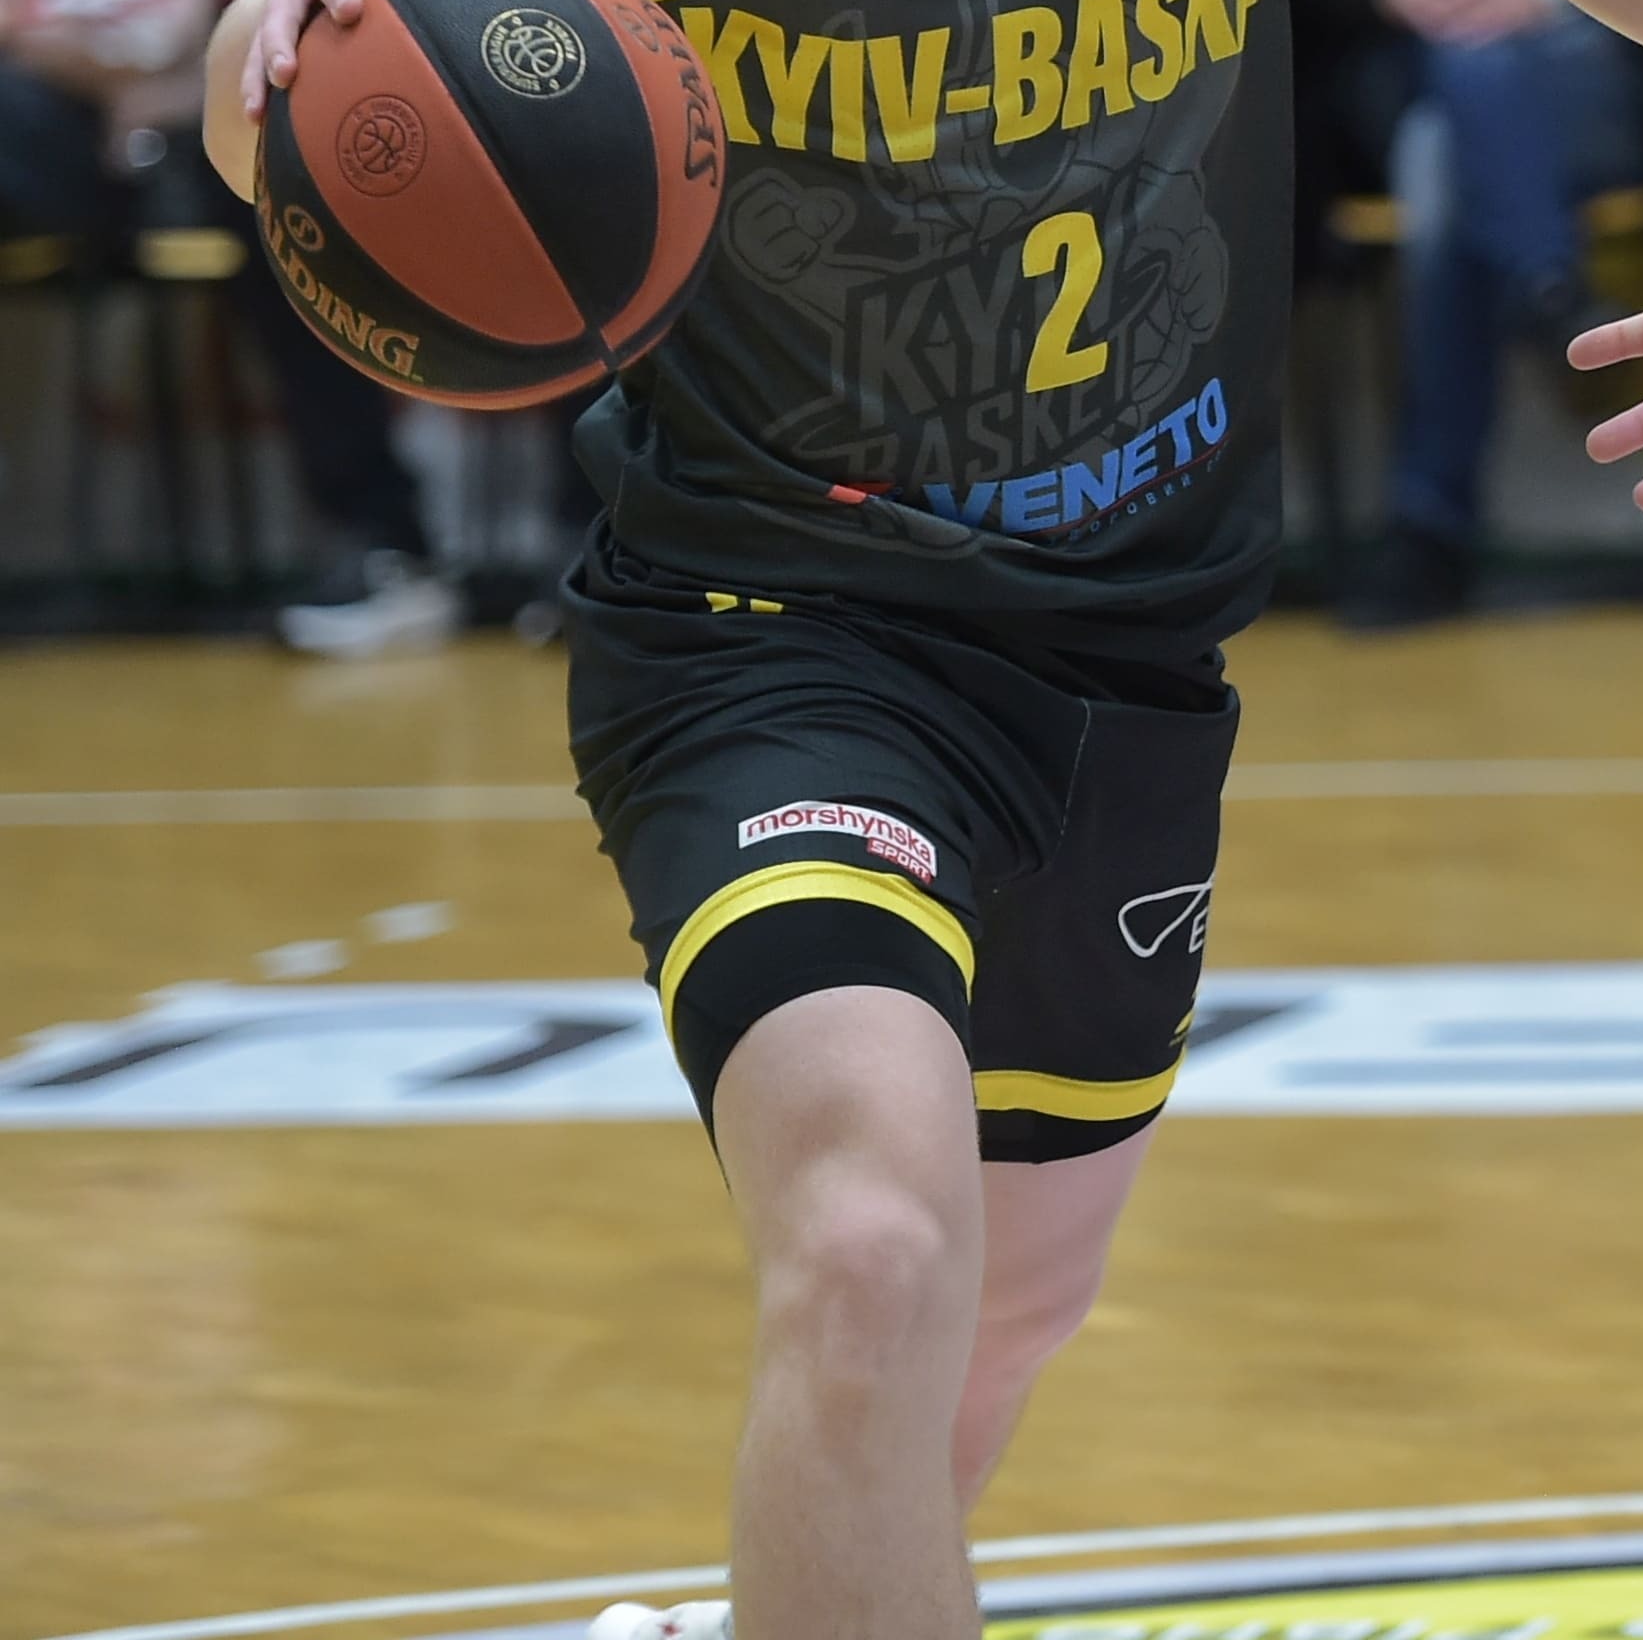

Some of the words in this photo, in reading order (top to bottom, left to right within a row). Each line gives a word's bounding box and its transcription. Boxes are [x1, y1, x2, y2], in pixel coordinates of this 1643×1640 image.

[1022, 211, 1108, 394] 2
[924, 377, 1228, 533] VENETO
[746, 806, 931, 863] morshynska
[870, 840, 930, 880] SPORT
